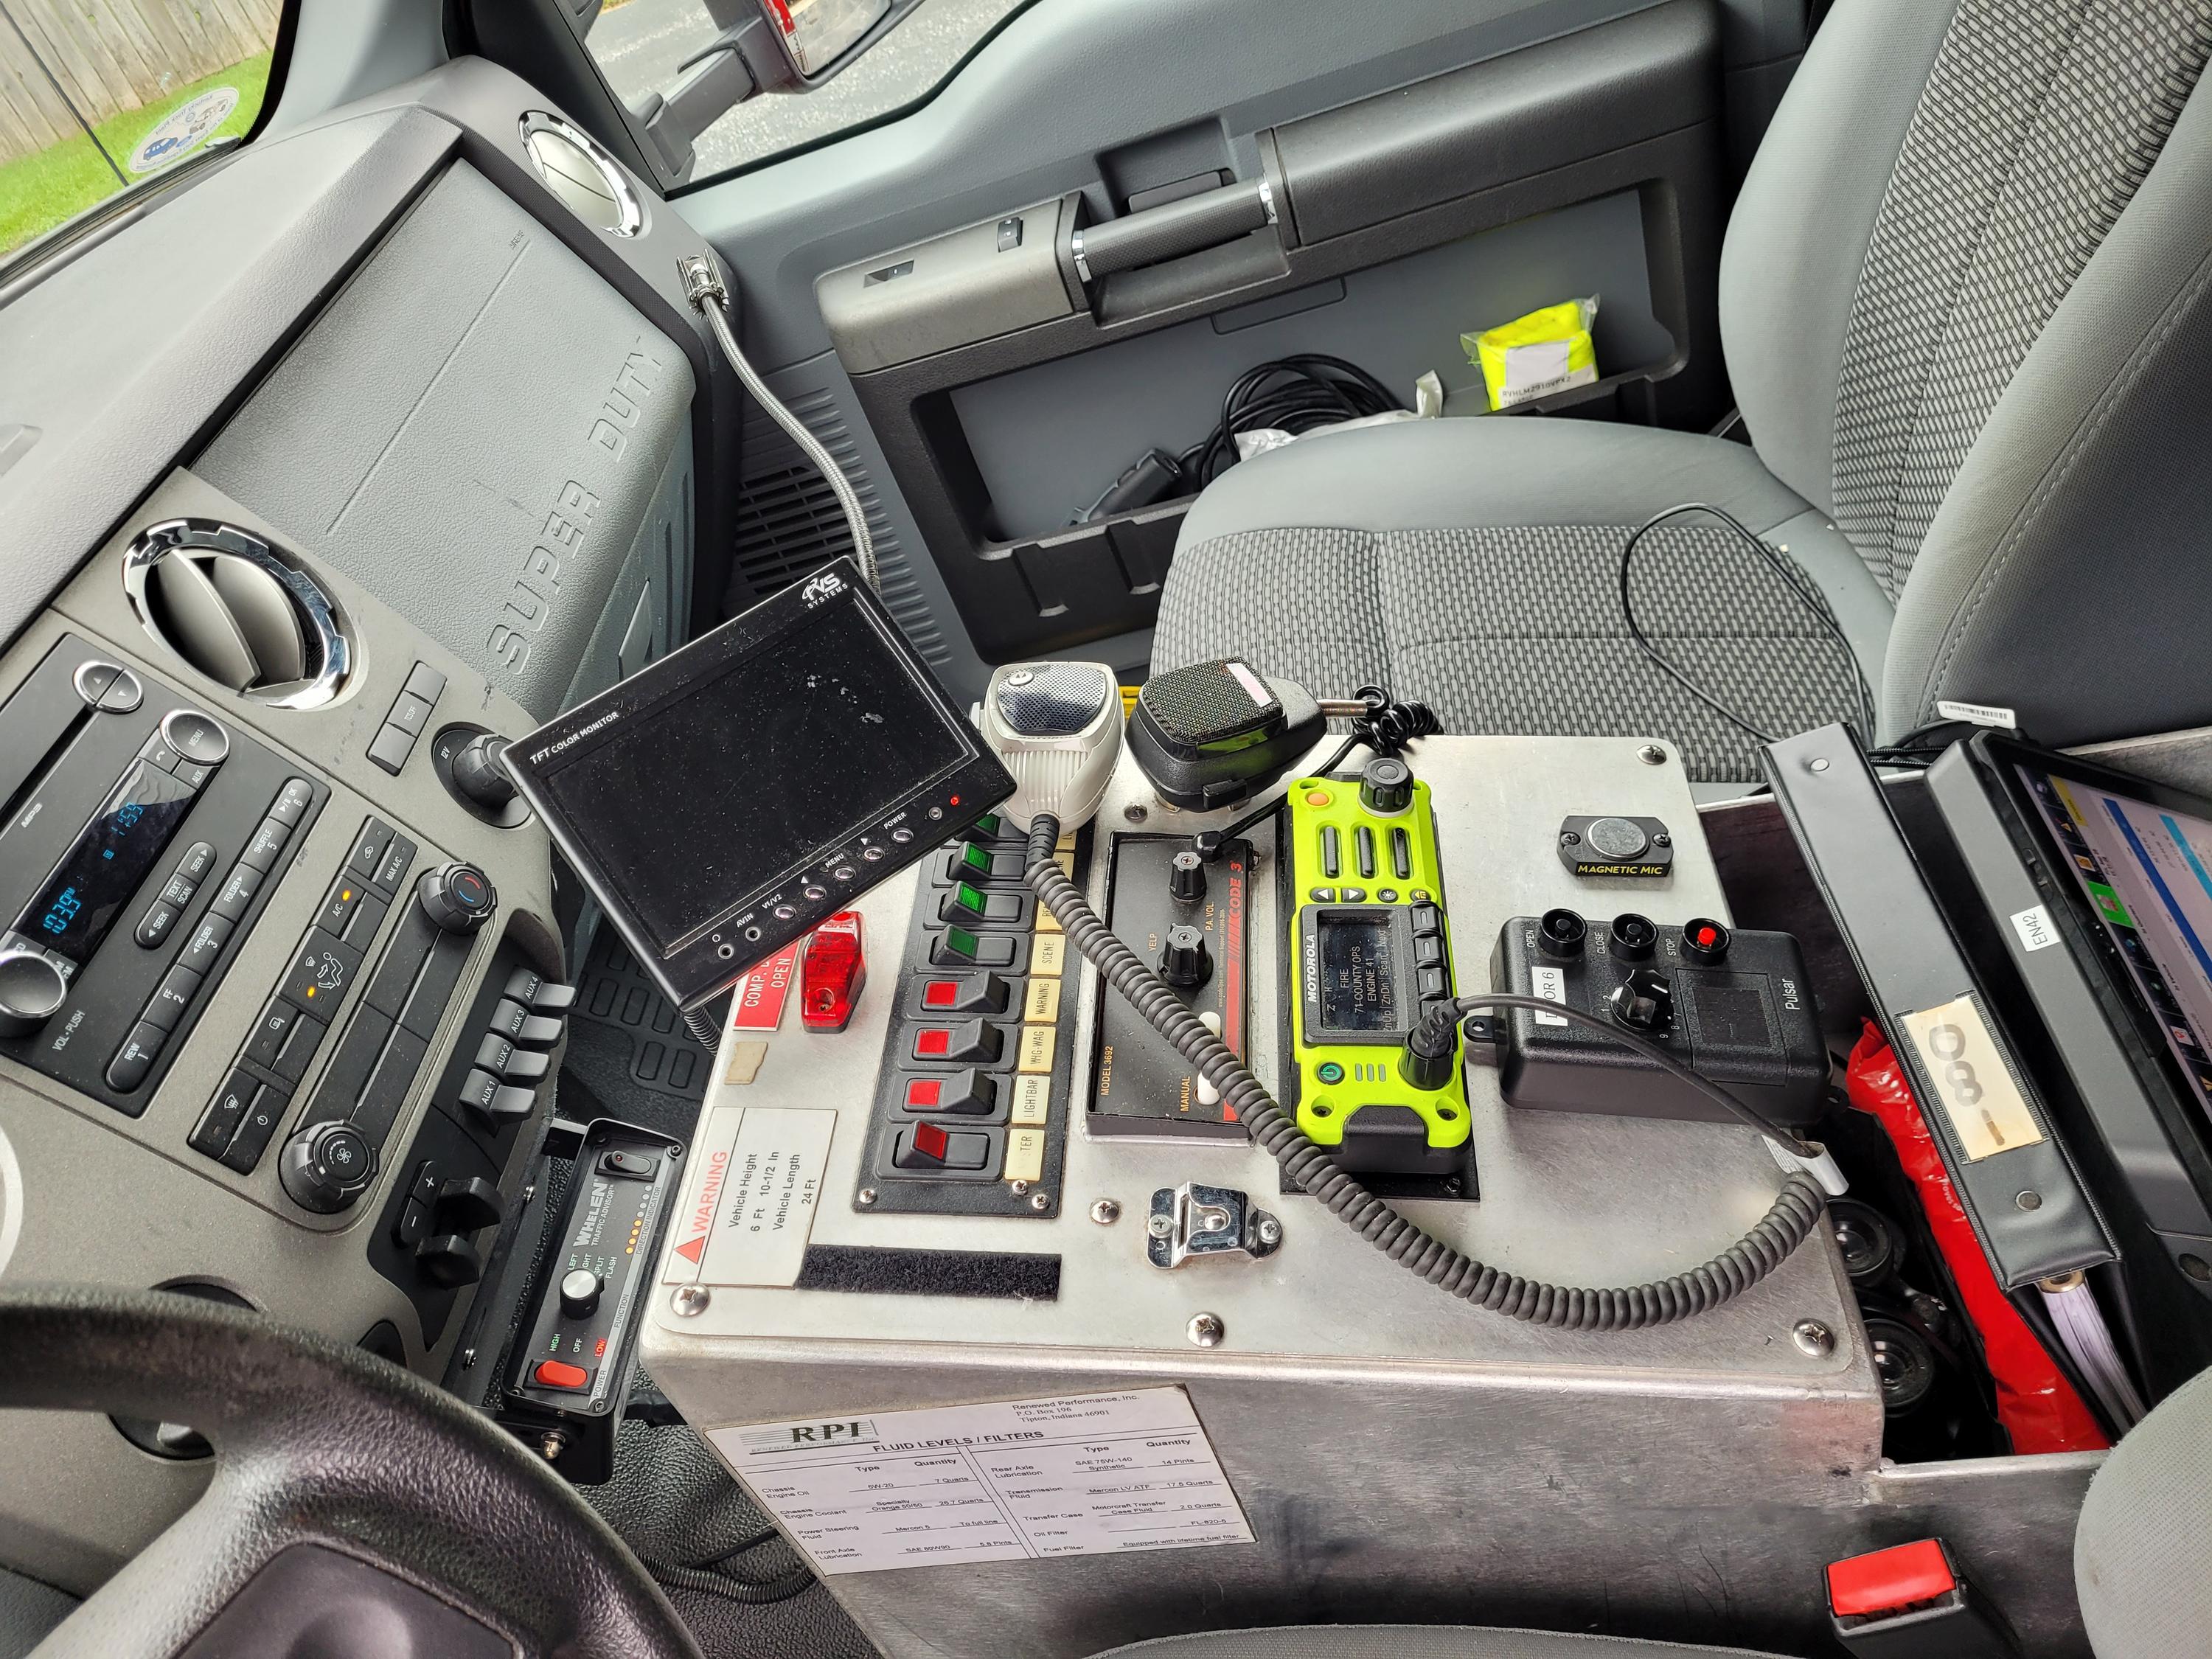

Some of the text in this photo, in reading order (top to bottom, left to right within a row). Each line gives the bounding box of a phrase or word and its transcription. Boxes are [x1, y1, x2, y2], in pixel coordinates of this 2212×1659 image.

[487, 335, 662, 675] SUPER DUTY
[807, 582, 849, 610] SYSTEMS
[189, 729, 204, 748] MENU
[529, 712, 619, 765] TFT COLOR MONITOR
[441, 745, 451, 759] 12V
[192, 770, 204, 784] AUX
[288, 787, 298, 796] OK
[293, 799, 303, 807] 6
[21, 802, 43, 828] MP3
[883, 811, 907, 831] POWER
[254, 829, 273, 854] SHUFFLE
[268, 842, 277, 850] 5
[190, 856, 204, 872] SEEK
[386, 856, 403, 882] MAX A/C
[824, 852, 845, 869] MENU
[1577, 865, 1663, 874] MAGNETIC MIC
[167, 880, 182, 897] TEXT
[178, 886, 192, 904] SCAN
[223, 880, 240, 902] FOLDER
[239, 889, 249, 898] 4
[1228, 862, 1242, 919] CODE 3
[332, 903, 344, 917] A/C
[762, 894, 783, 910] V1/V2
[43, 894, 82, 934] 103.9
[153, 911, 170, 930] SEEK
[736, 913, 754, 928] AVIN
[195, 926, 214, 950] FOLDER
[1526, 930, 1535, 947] OPEN
[2023, 913, 2048, 945] EN42
[207, 940, 218, 949] 3
[1149, 933, 1158, 951] YELP
[1594, 932, 1606, 954] CLOSE
[1666, 938, 1677, 956] STOP
[1041, 941, 1054, 964] SCENE
[771, 958, 791, 988] OPEN
[1305, 934, 1317, 1002] MOTOROLA
[1542, 972, 1554, 980] 6
[1340, 968, 1350, 989] FIRE
[1352, 946, 1365, 1013] 71-COUNTY OPS
[1365, 957, 1377, 1002] ENGINE 41
[1380, 955, 1391, 1005] ZnDn Scan
[162, 988, 174, 999] FF
[173, 995, 184, 1004] 2
[524, 983, 538, 999] AUX
[1035, 982, 1049, 1015] WARNING
[1782, 978, 1801, 1010] Pulsar
[52, 1010, 86, 1051] VOL PUSH
[510, 1015, 523, 1034] AUX
[124, 1043, 141, 1060] REW
[496, 1051, 509, 1068] AUX
[1101, 1046, 1113, 1096] MODEL 3692
[481, 1087, 494, 1105] AUX
[1023, 1079, 1038, 1118] LIGHTBAR
[1180, 1076, 1190, 1112] MANUAL
[728, 1154, 758, 1228] Vehicle Height
[759, 1166, 776, 1197] 10-1/2
[692, 1151, 728, 1233] WARNING
[773, 1154, 800, 1231] Vehicle Length
[801, 1179, 816, 1204] 24 Ft
[573, 1182, 608, 1246] WHELEN
[636, 1187, 661, 1255] DIRECTION INDICATOR
[754, 1208, 765, 1220] Ft
[591, 1220, 605, 1246] TRAFFIC
[568, 1253, 578, 1270] LEFT
[605, 1256, 618, 1279] FLASH
[614, 1293, 630, 1328] FUNCTION
[549, 1333, 561, 1352] HIGH
[573, 1338, 582, 1353] OFF
[594, 1339, 605, 1357] LOW
[594, 1370, 607, 1397] POWER
[1012, 1402, 1056, 1411] Renewed
[790, 1422, 860, 1444] RPI
[873, 1431, 1044, 1452] FLUID LEVELS FILTERS
[1146, 1439, 1191, 1447] Quantity
[914, 1458, 957, 1467] Quantity
[1088, 1464, 1126, 1472] Synthetic
[994, 1470, 1043, 1478] Lubrication
[1005, 1486, 1063, 1495] Transmission
[818, 1552, 862, 1560] Lubrication
